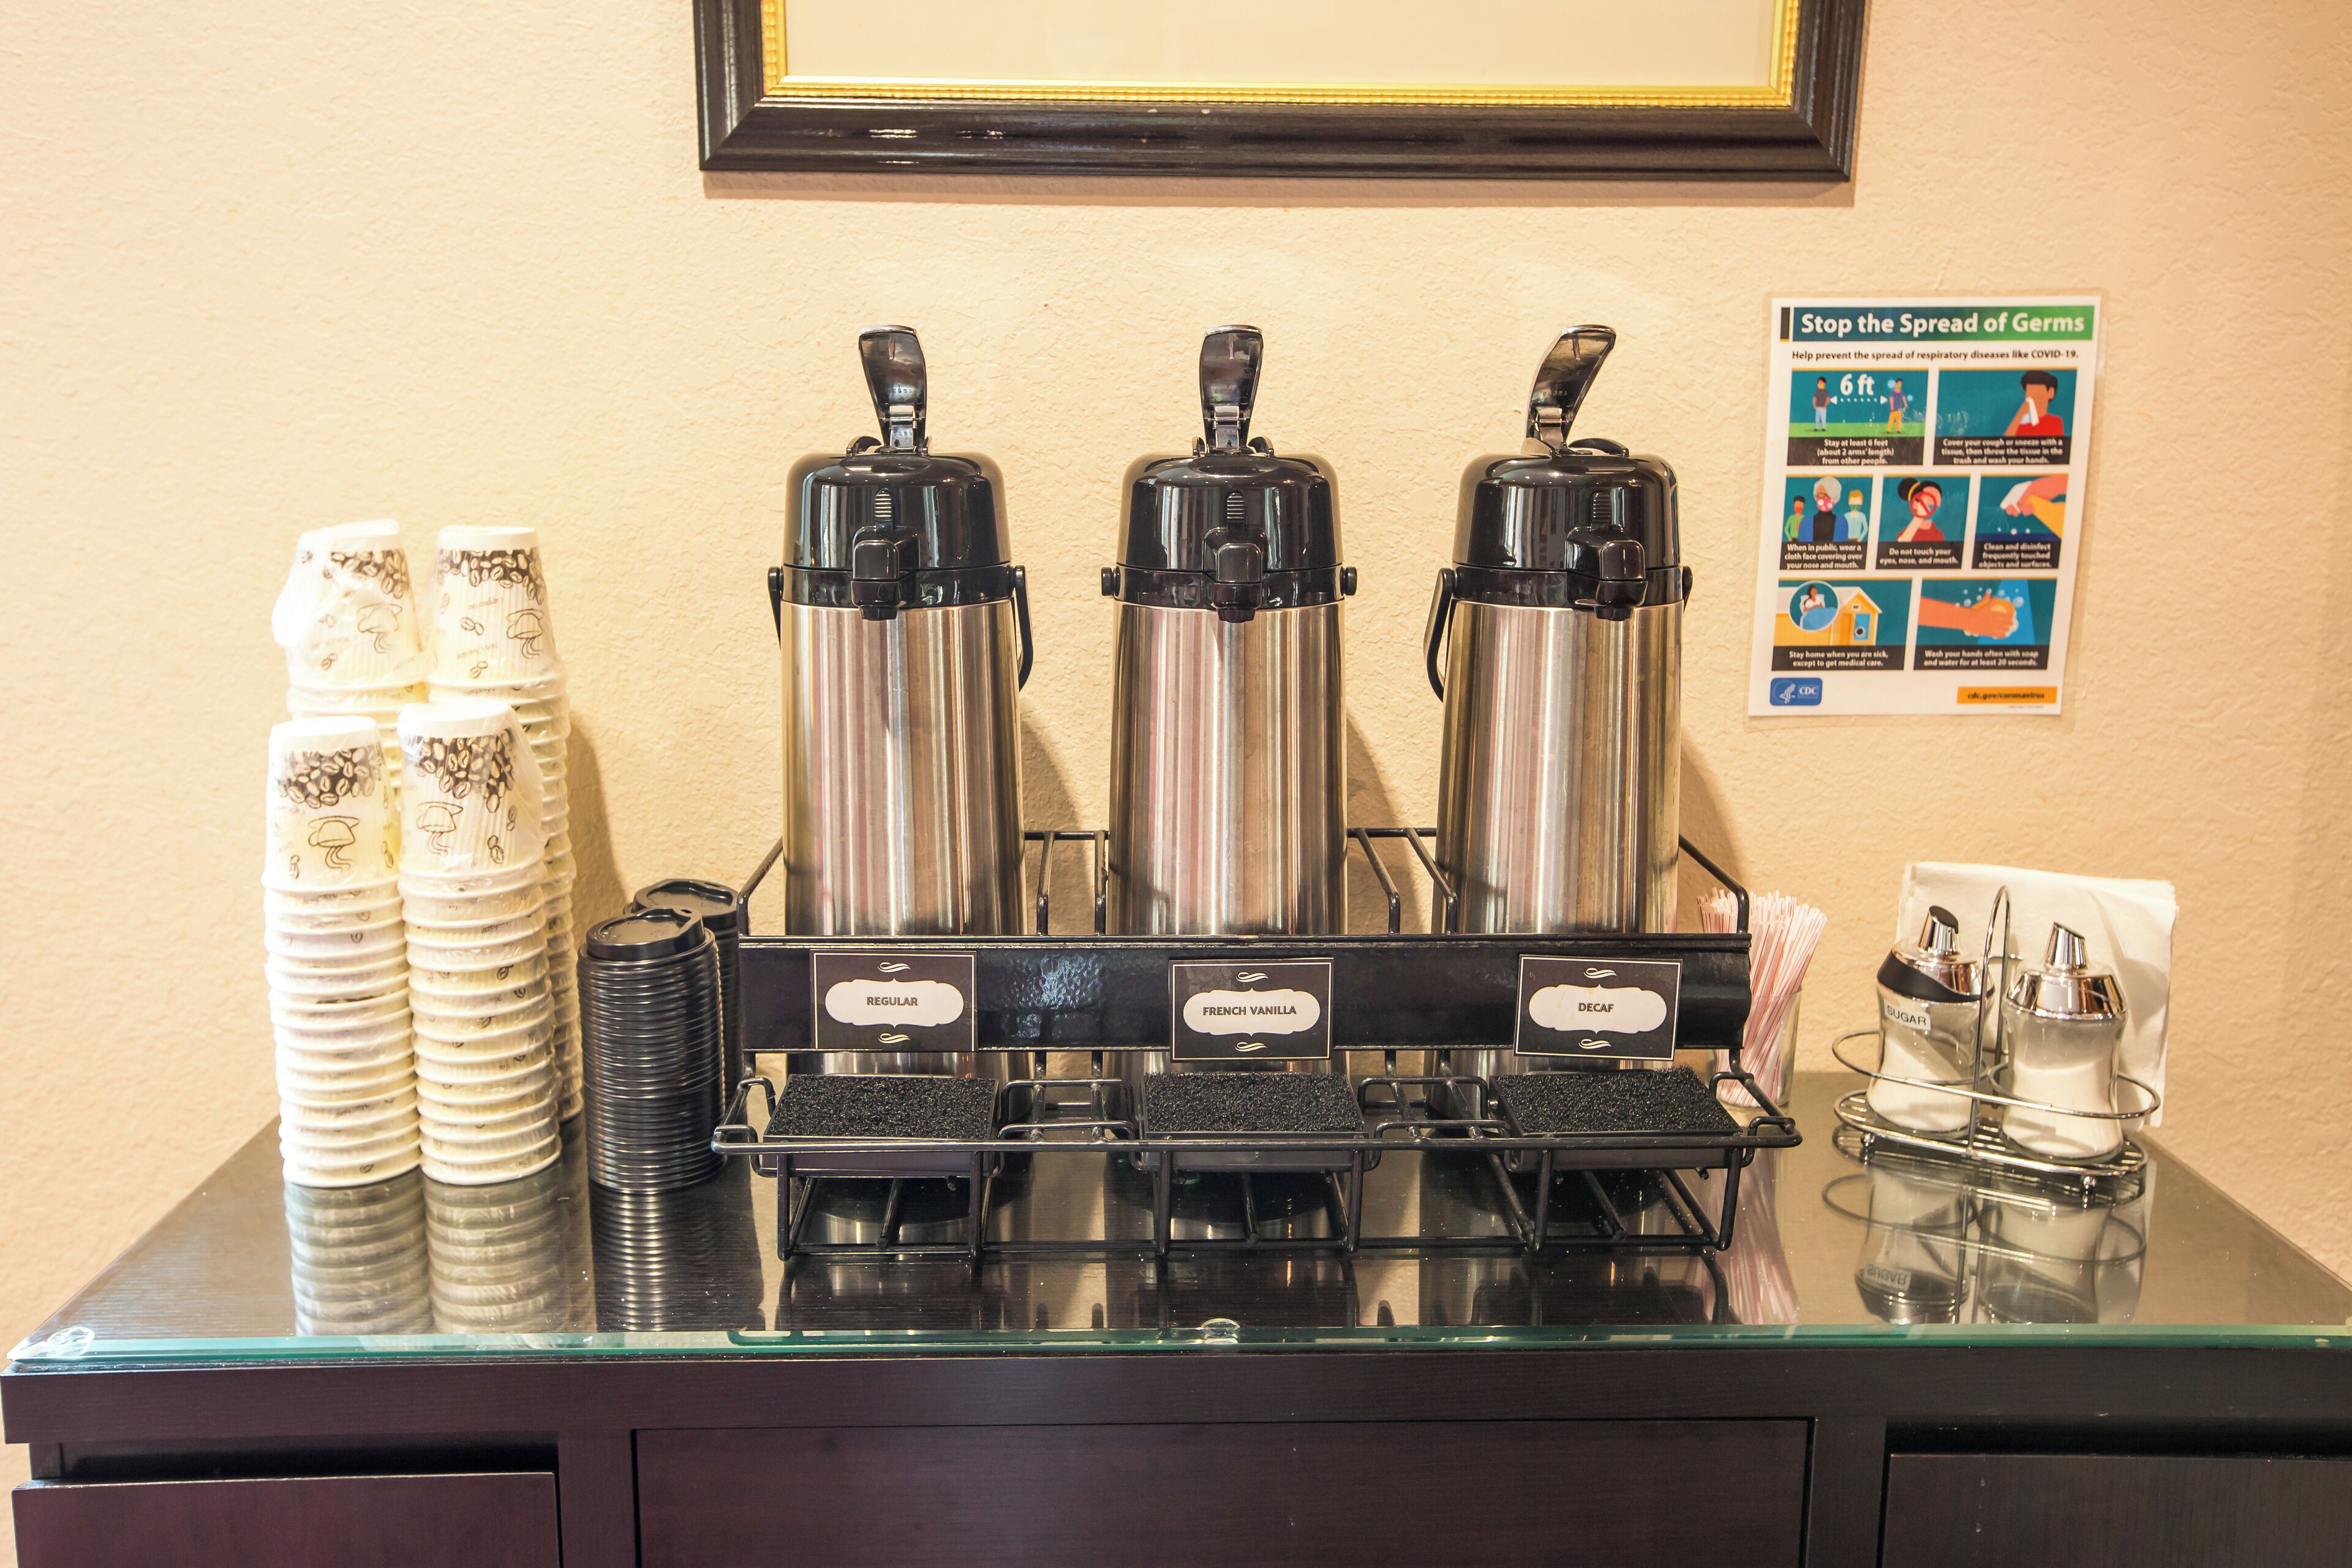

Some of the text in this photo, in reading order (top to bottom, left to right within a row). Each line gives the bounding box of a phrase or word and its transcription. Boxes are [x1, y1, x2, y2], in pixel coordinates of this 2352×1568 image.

[1801, 312, 2085, 337] Stop the Spread of Germs
[1792, 351, 1813, 361] Help
[1816, 352, 1852, 361] prevent
[1872, 351, 1902, 361] spread
[1905, 350, 1914, 359] of
[1917, 351, 1968, 361] respiratory
[1970, 350, 2010, 359] diseases
[2012, 350, 2029, 359] like
[2031, 350, 2079, 359] COVID-19.
[1840, 373, 1875, 396] 6 ft
[1824, 439, 1839, 448] Stay
[1982, 439, 2004, 447] cough
[1815, 544, 1838, 552] public,
[1818, 552, 1846, 561] covering
[1789, 650, 1804, 660] Stay
[1799, 686, 1817, 696] CDC
[867, 996, 918, 1006] REGULAR
[1202, 1005, 1297, 1016] FRENCH VANILLA
[1578, 1002, 1615, 1012] DECAF
[1887, 1005, 1926, 1026] SUGAR
